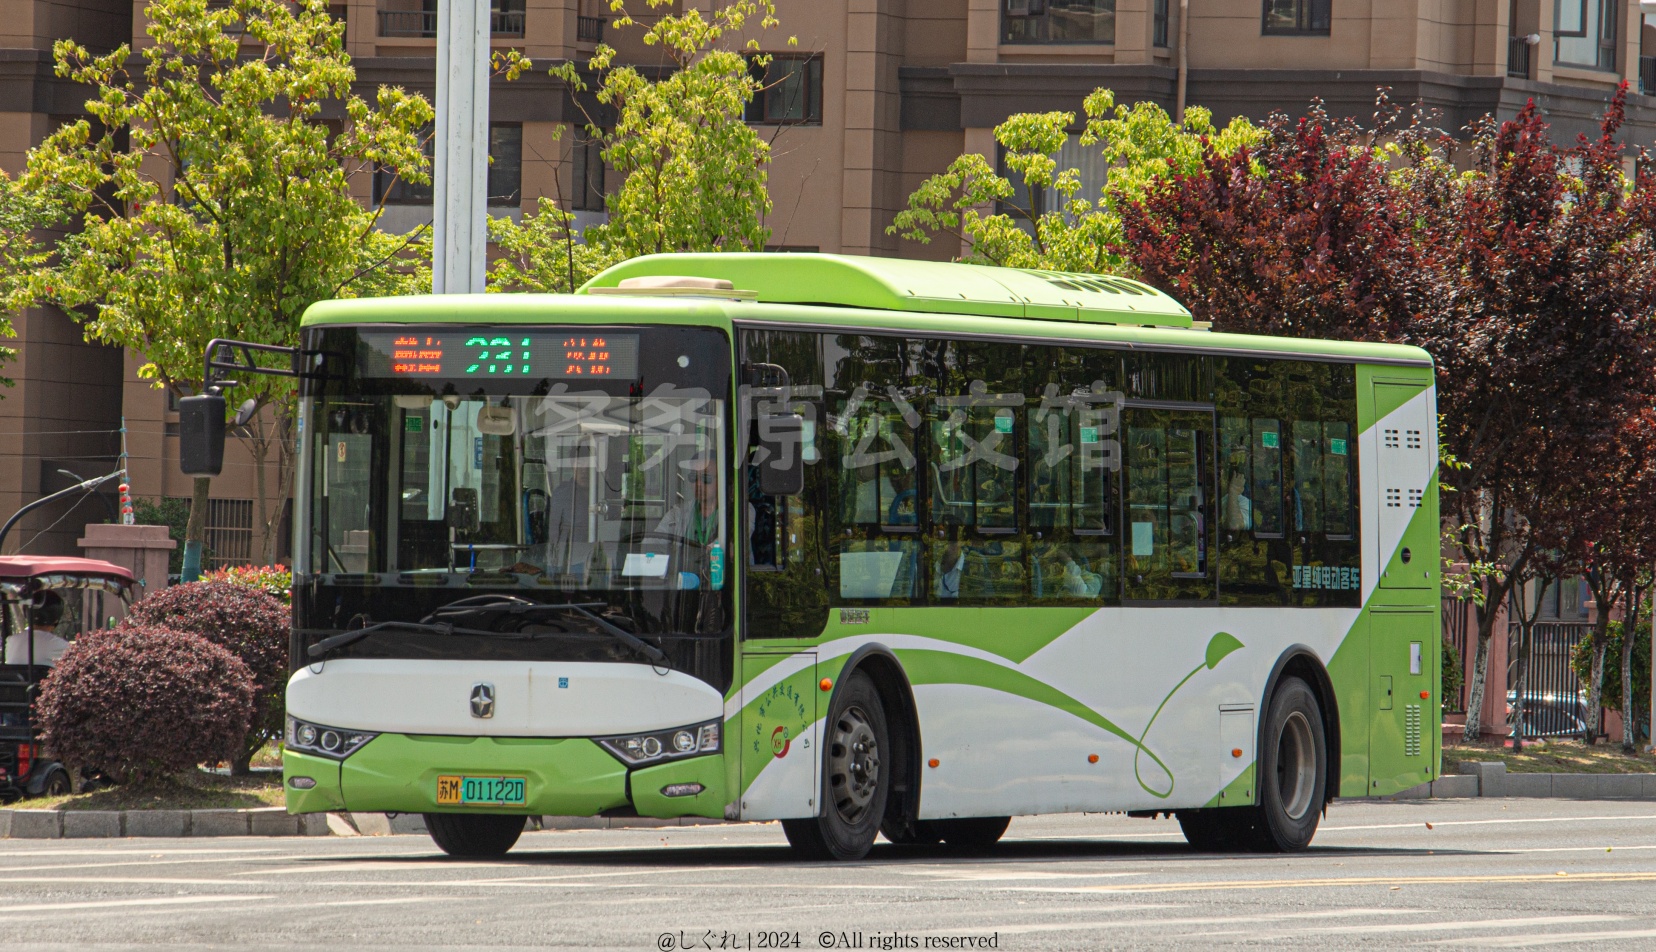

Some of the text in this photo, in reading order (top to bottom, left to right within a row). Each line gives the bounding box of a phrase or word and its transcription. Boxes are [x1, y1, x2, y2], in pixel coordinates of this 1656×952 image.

[1292, 565, 1360, 591] 亚星纯电动客车
